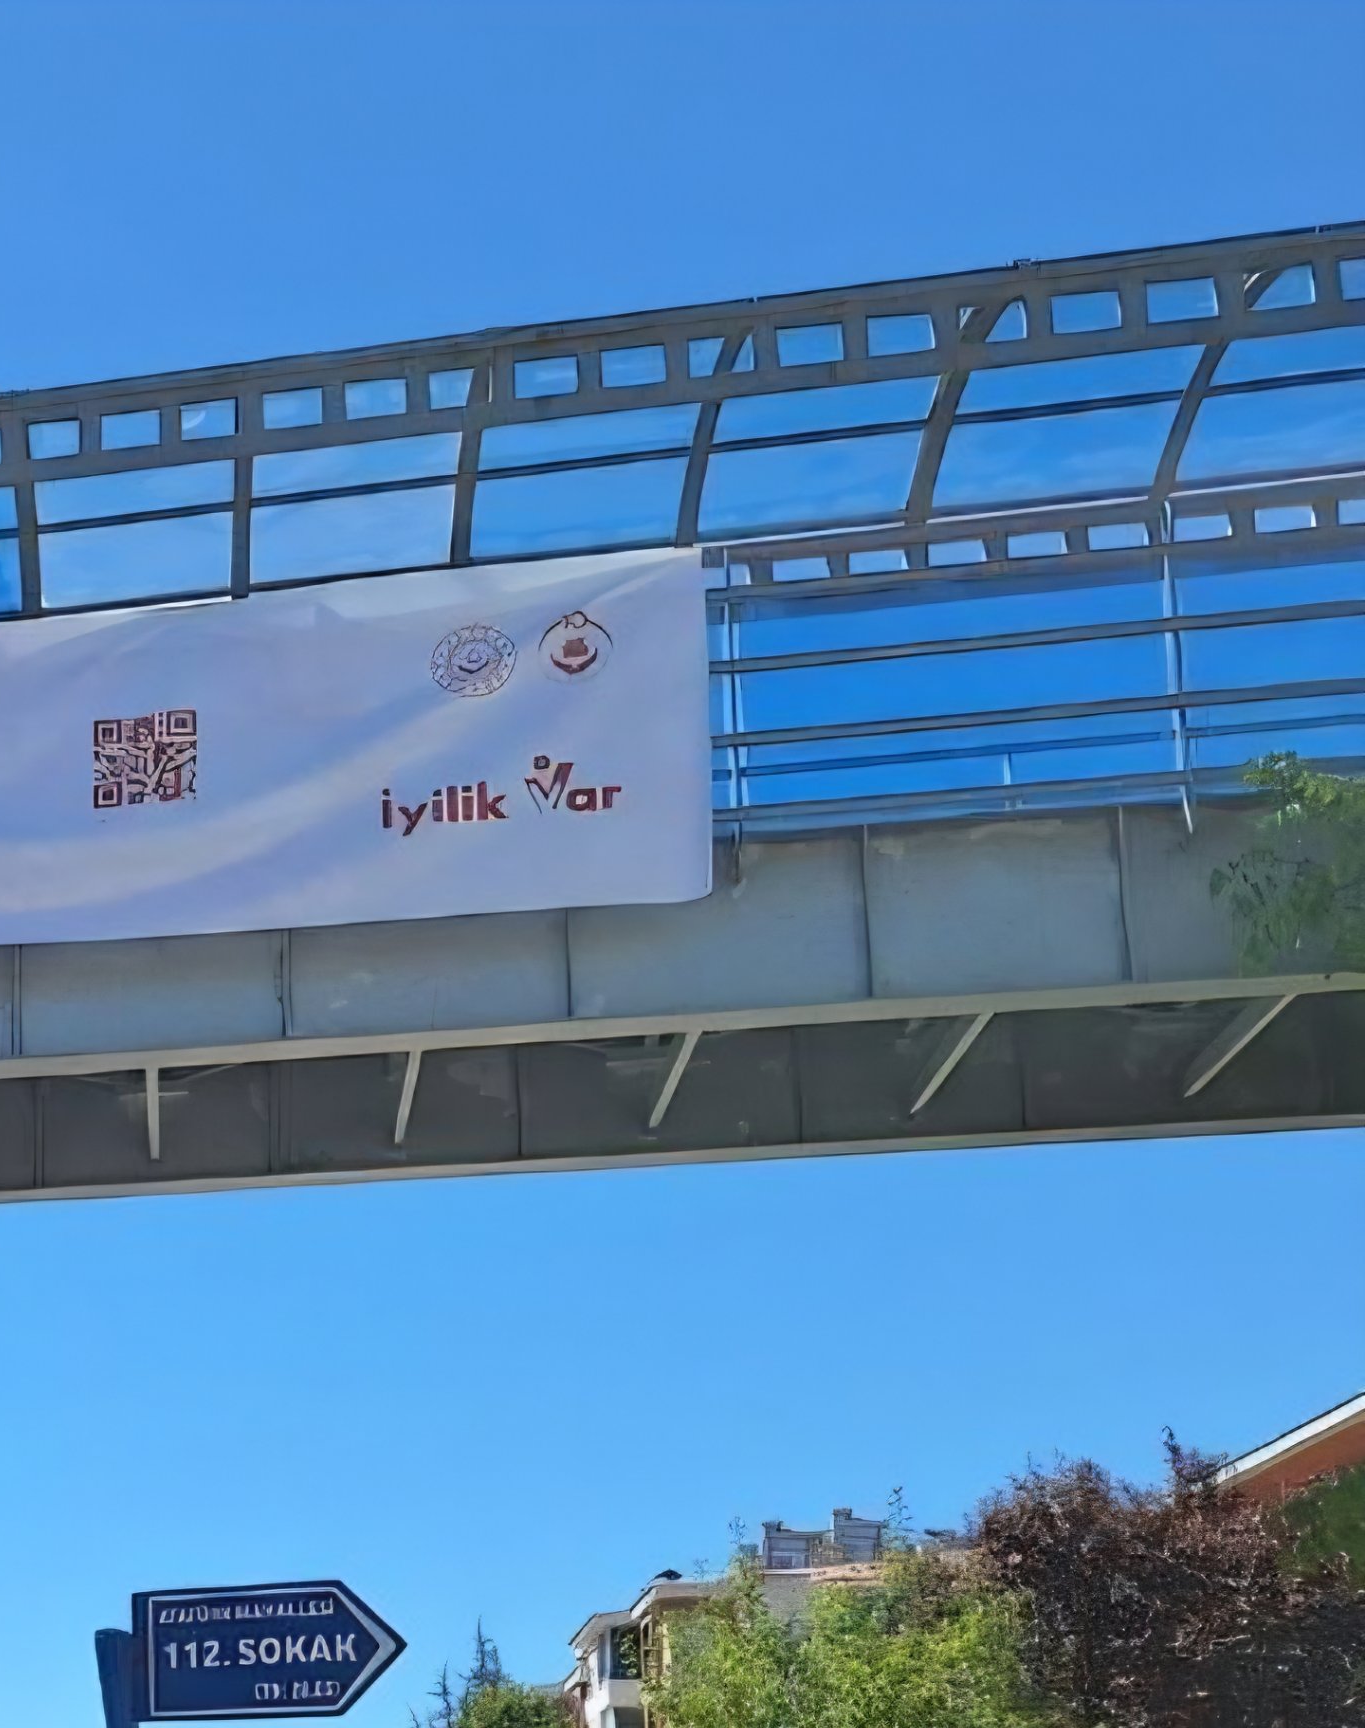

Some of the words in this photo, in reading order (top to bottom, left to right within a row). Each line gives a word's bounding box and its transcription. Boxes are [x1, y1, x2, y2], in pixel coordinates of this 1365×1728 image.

[524, 756, 622, 815] Var
[164, 1640, 231, 1669] 112.
[238, 1633, 358, 1666] SOKAK
